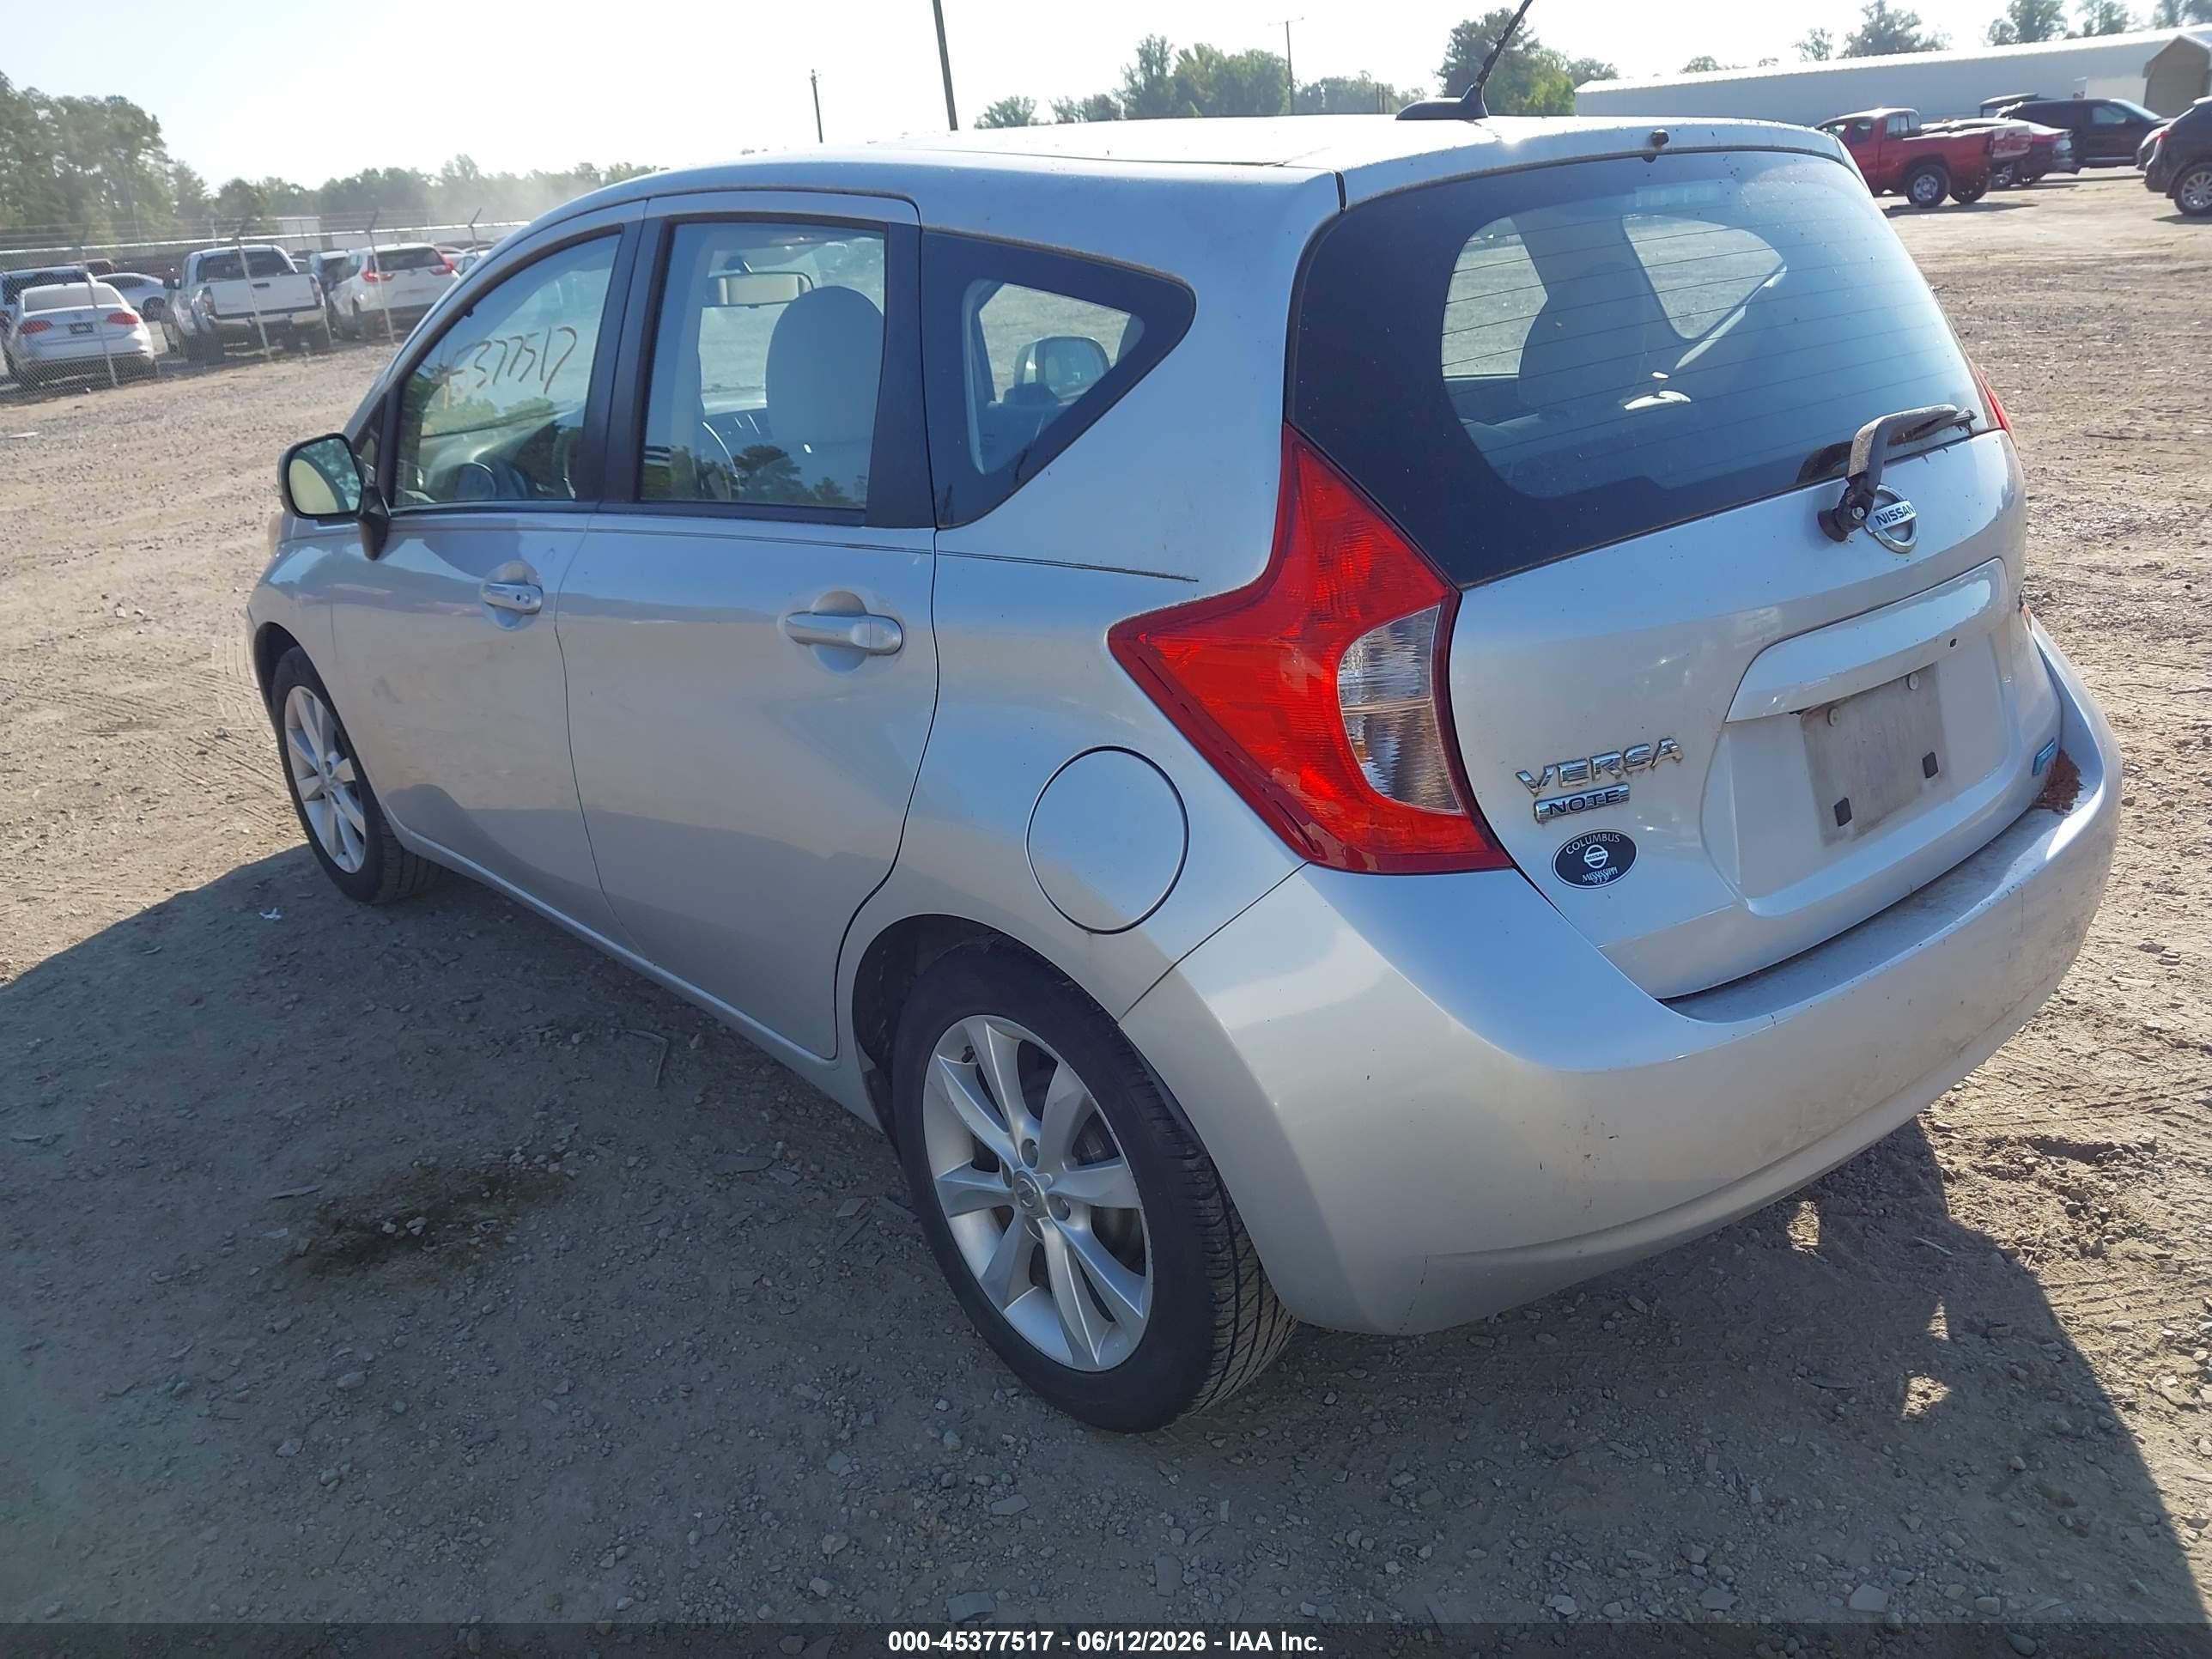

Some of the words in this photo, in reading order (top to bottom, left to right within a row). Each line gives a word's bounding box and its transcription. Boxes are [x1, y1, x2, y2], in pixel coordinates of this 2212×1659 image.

[1875, 504, 1915, 526] NISSAN
[1515, 737, 1684, 797] VERSA
[1548, 789, 1621, 816] NOTE
[1565, 833, 1620, 854] COLUMBUS
